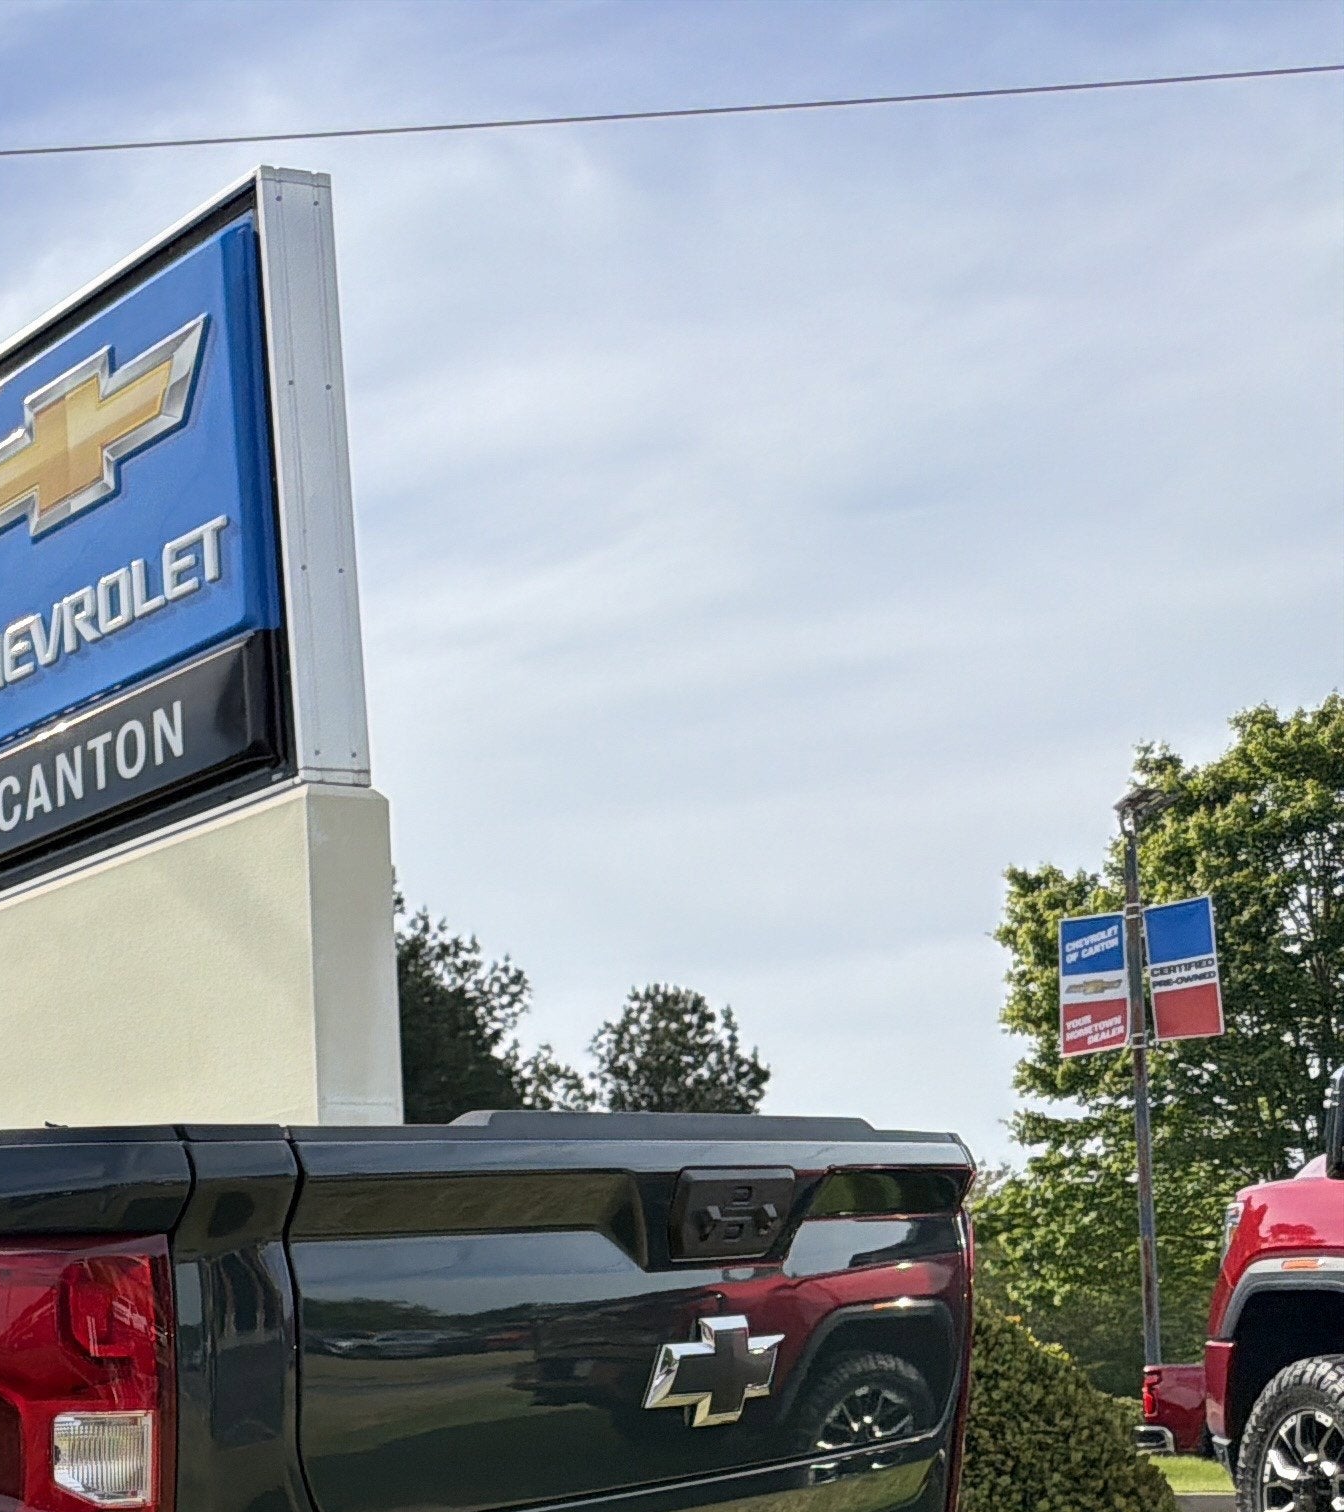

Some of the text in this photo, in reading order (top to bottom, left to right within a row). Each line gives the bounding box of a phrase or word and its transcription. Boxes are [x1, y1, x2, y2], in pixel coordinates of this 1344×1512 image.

[1065, 924, 1119, 953] CHEVROLET
[1065, 937, 1119, 964] OF CANTON
[1151, 957, 1215, 977] CERTIFIED
[1152, 970, 1217, 988] PRE-OWNED
[1065, 1015, 1122, 1041] HOMETOWN
[1066, 1015, 1092, 1030] YOUR
[1087, 1025, 1125, 1045] DEALER
